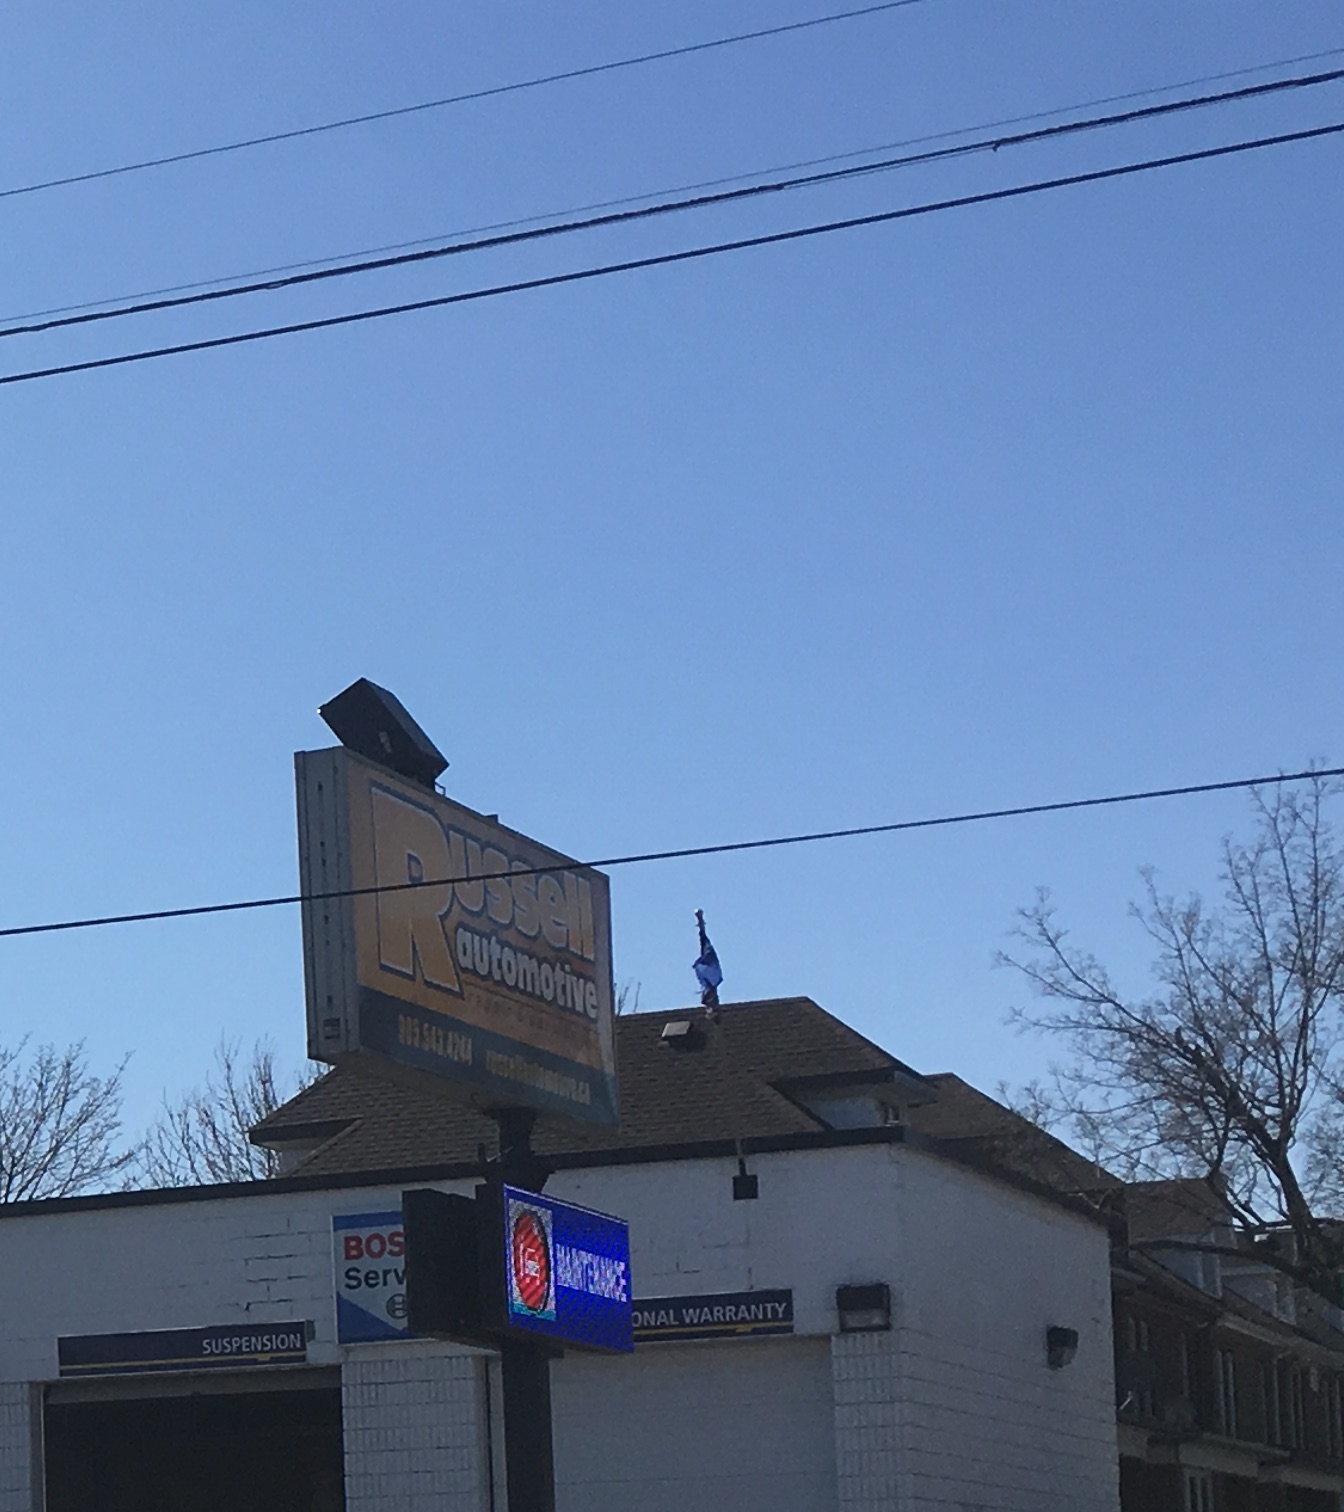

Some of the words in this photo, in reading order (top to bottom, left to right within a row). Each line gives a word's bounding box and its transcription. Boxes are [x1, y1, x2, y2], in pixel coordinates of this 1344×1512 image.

[370, 783, 596, 998] Russell
[456, 926, 599, 1019] automotive
[682, 1302, 787, 1324] WARRANTY
[202, 1333, 301, 1354] SUSPENSION
